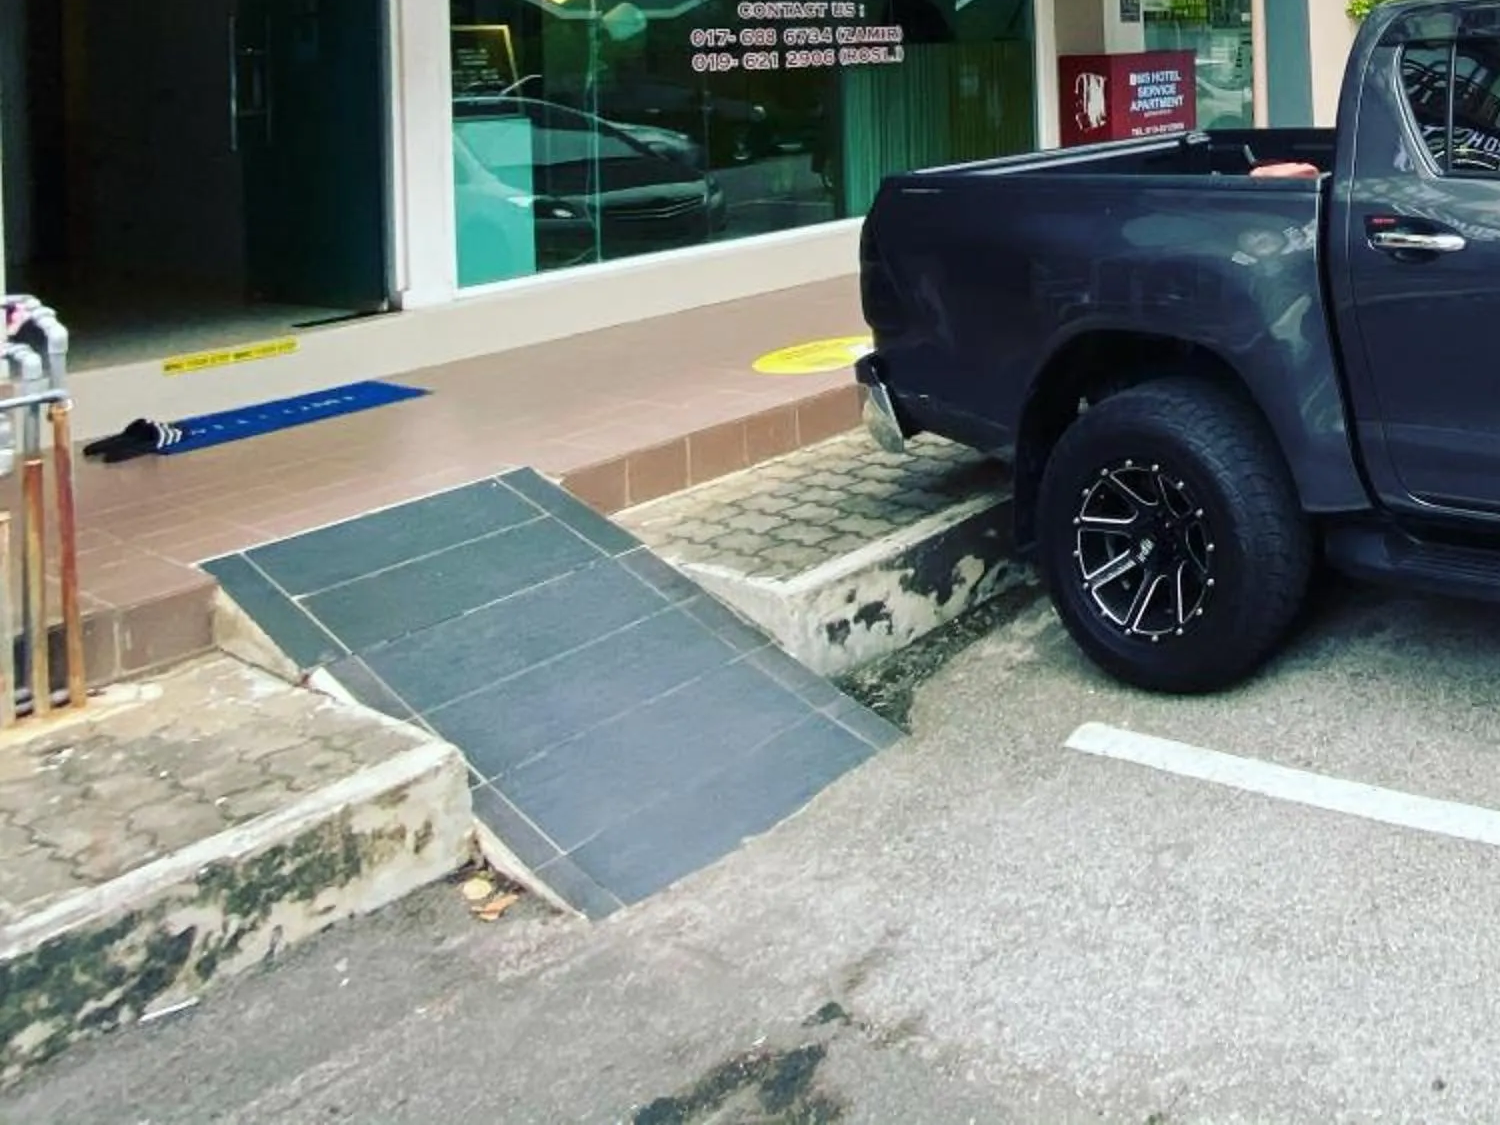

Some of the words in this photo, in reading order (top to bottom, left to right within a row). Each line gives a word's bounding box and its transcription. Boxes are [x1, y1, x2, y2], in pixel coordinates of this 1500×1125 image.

[738, 1, 828, 20] CONTACT
[831, 2, 856, 19] US
[1152, 70, 1182, 83] HOTEL
[1137, 83, 1177, 98] SERVICE
[1130, 95, 1184, 112] APARTMENT
